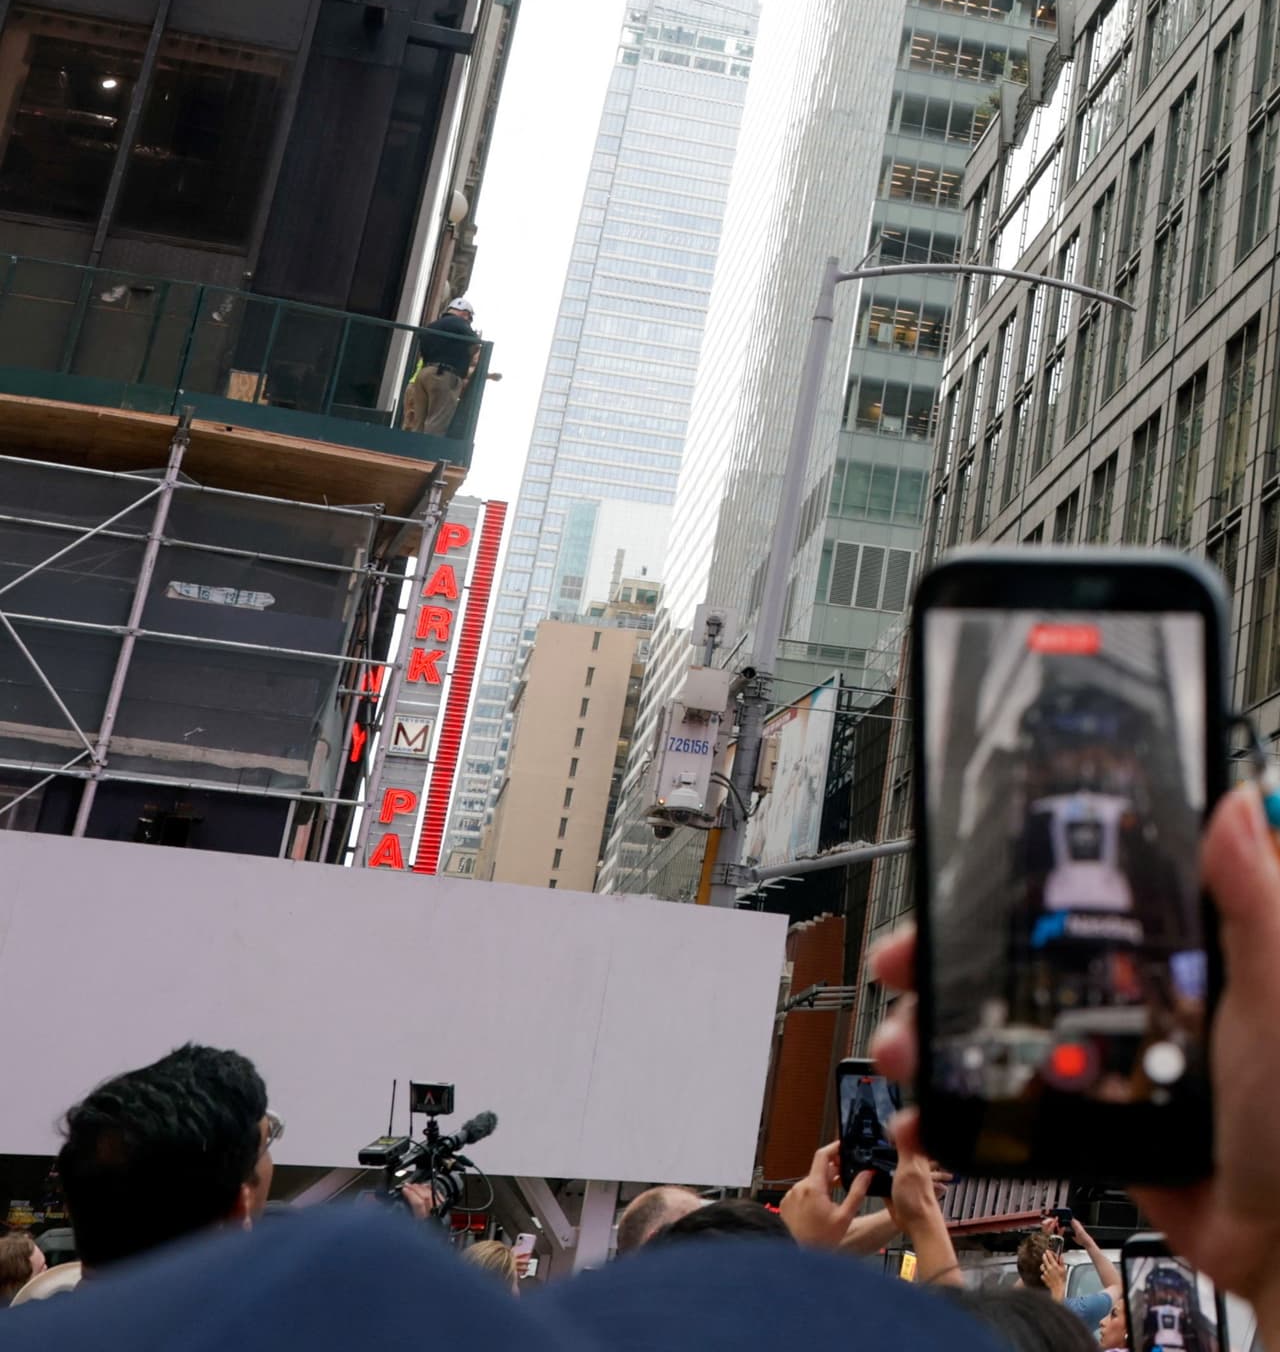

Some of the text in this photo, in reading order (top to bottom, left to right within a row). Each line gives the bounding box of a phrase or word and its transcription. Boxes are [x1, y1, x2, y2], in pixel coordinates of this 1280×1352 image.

[407, 522, 471, 684] PARK
[669, 736, 709, 755] 726156
[368, 787, 417, 869] PA
